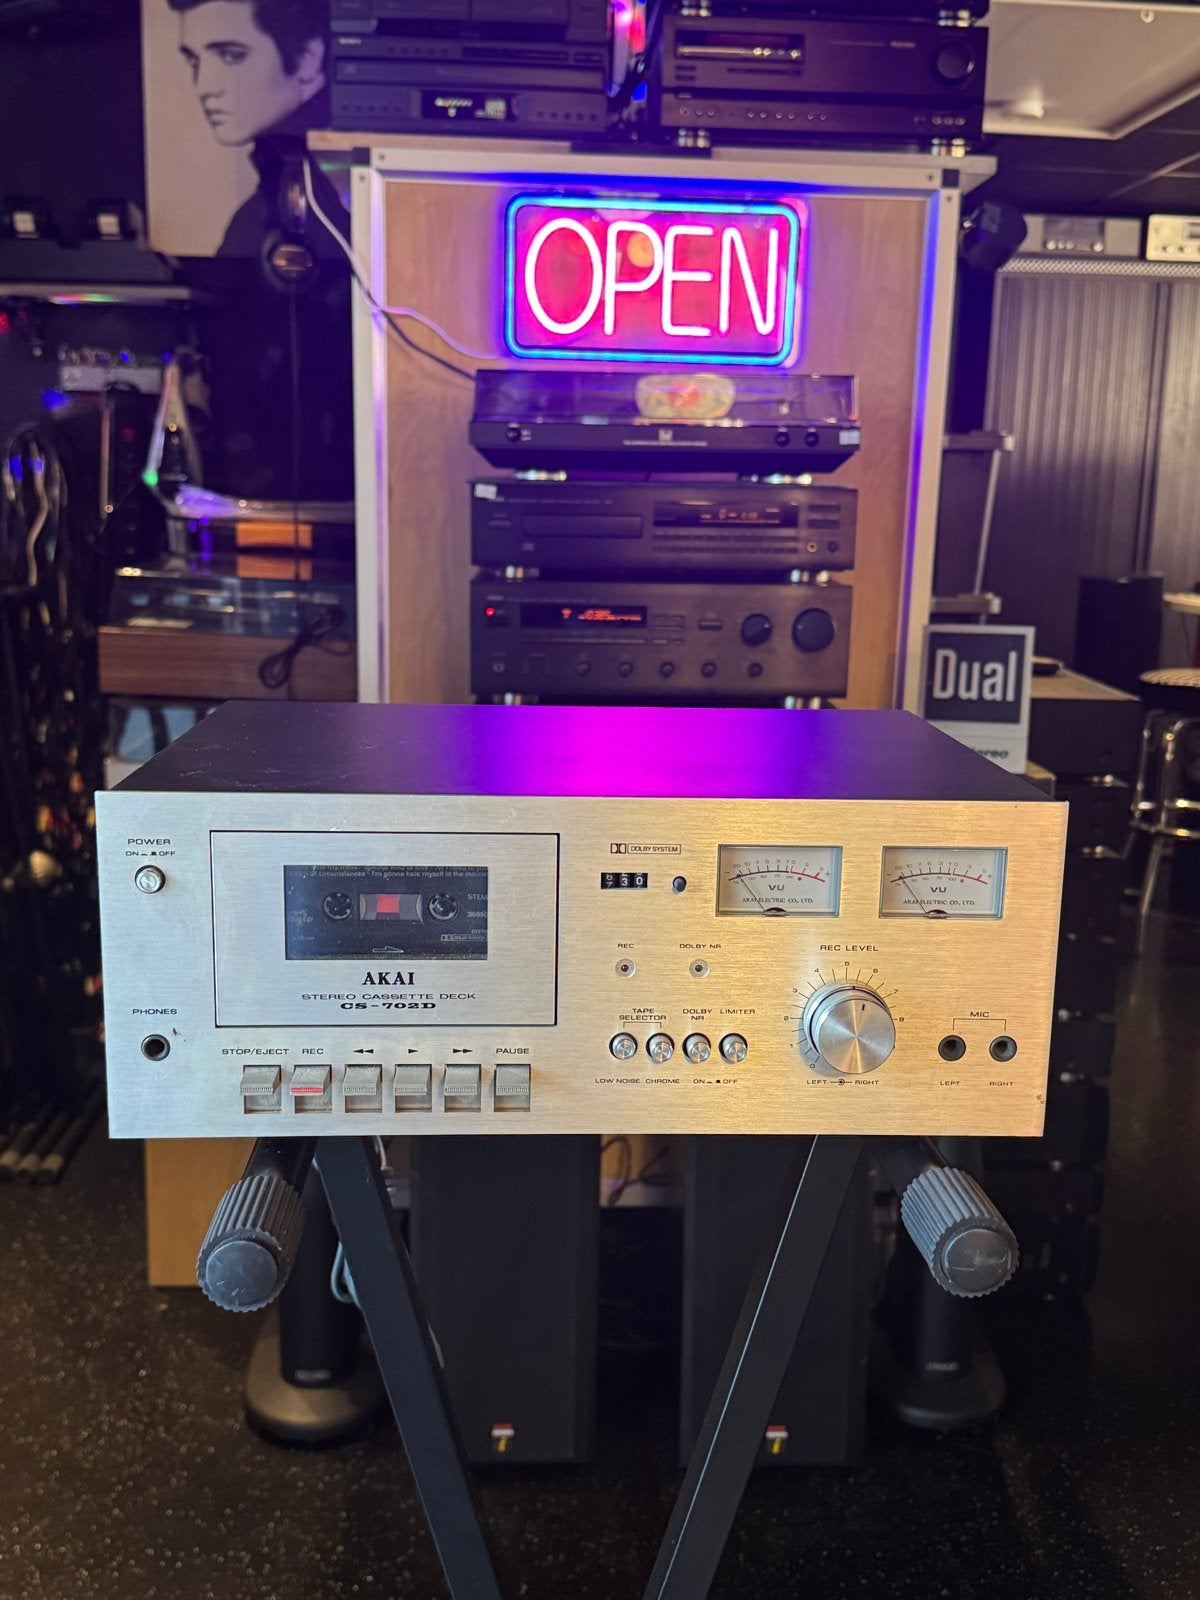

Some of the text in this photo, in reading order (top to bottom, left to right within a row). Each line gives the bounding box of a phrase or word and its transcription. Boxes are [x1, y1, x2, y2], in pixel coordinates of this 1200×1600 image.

[524, 217, 779, 337] OPEN
[932, 648, 1018, 702] Dual
[383, 871, 406, 879] gonna
[421, 870, 444, 878] myself
[361, 971, 415, 985] AKAI
